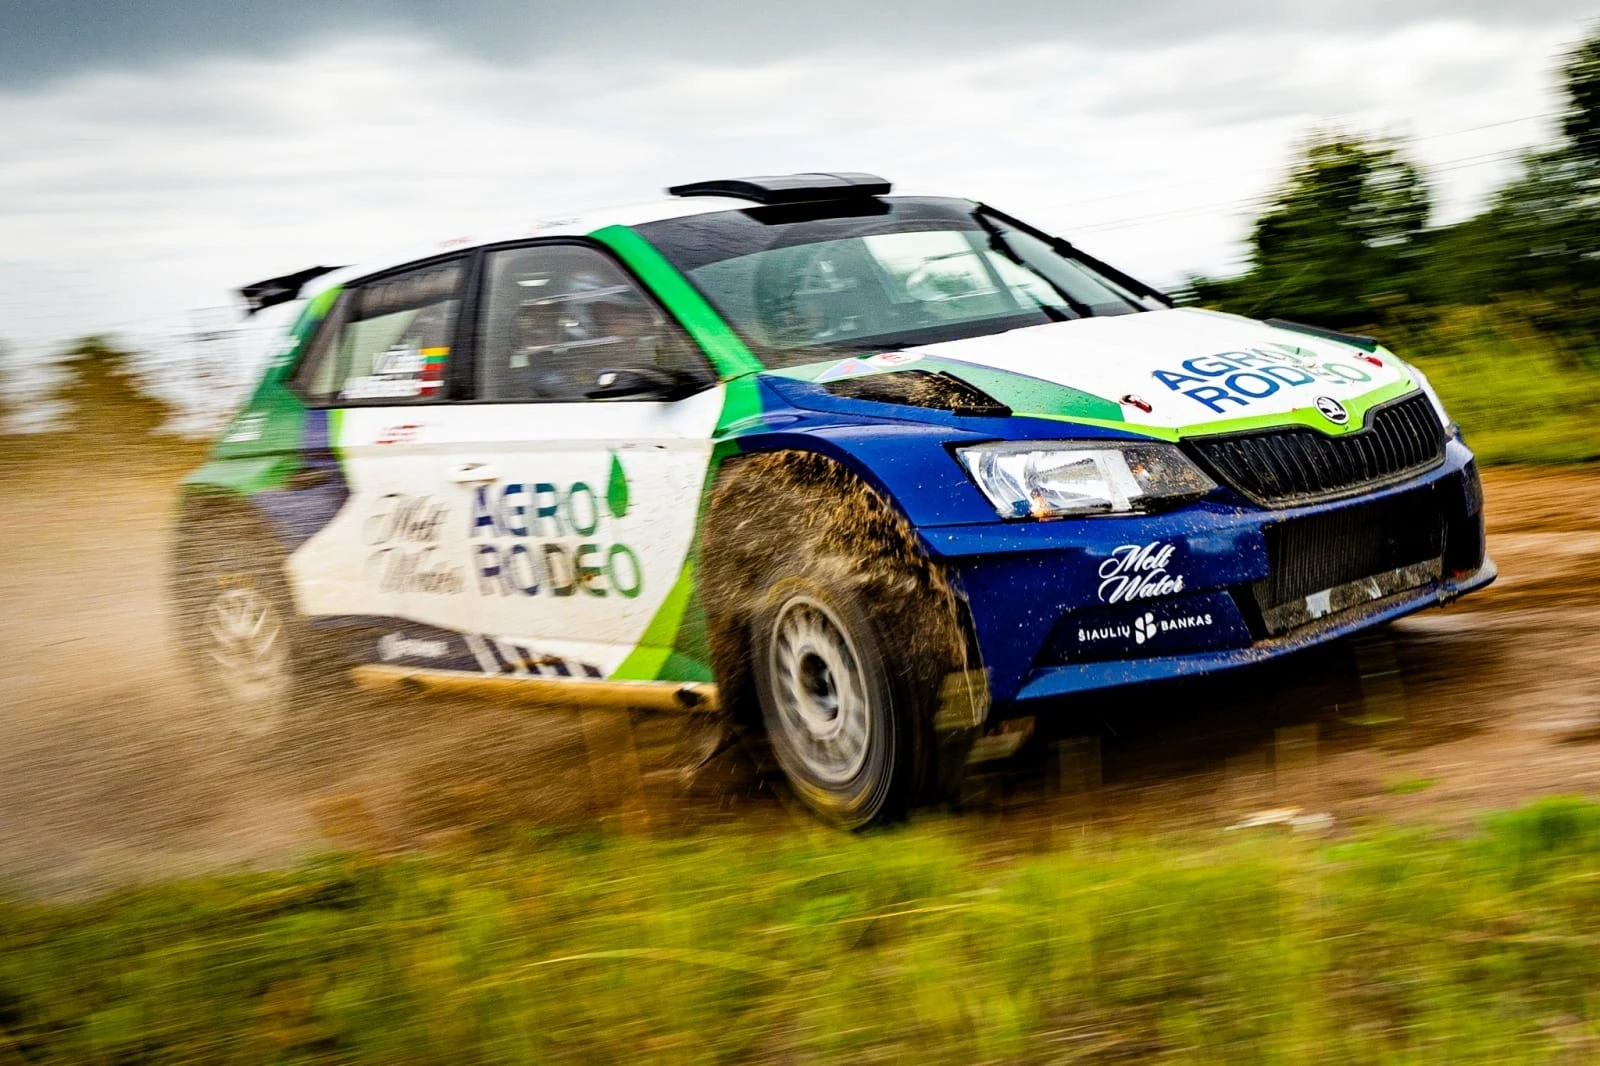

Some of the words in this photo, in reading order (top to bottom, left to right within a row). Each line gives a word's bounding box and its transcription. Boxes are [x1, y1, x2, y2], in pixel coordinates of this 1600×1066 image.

[470, 482, 599, 538] AGRO
[473, 543, 643, 599] RODEO
[1098, 541, 1176, 579] Melt
[1098, 568, 1184, 604] Water
[1160, 613, 1213, 631] BANKAS
